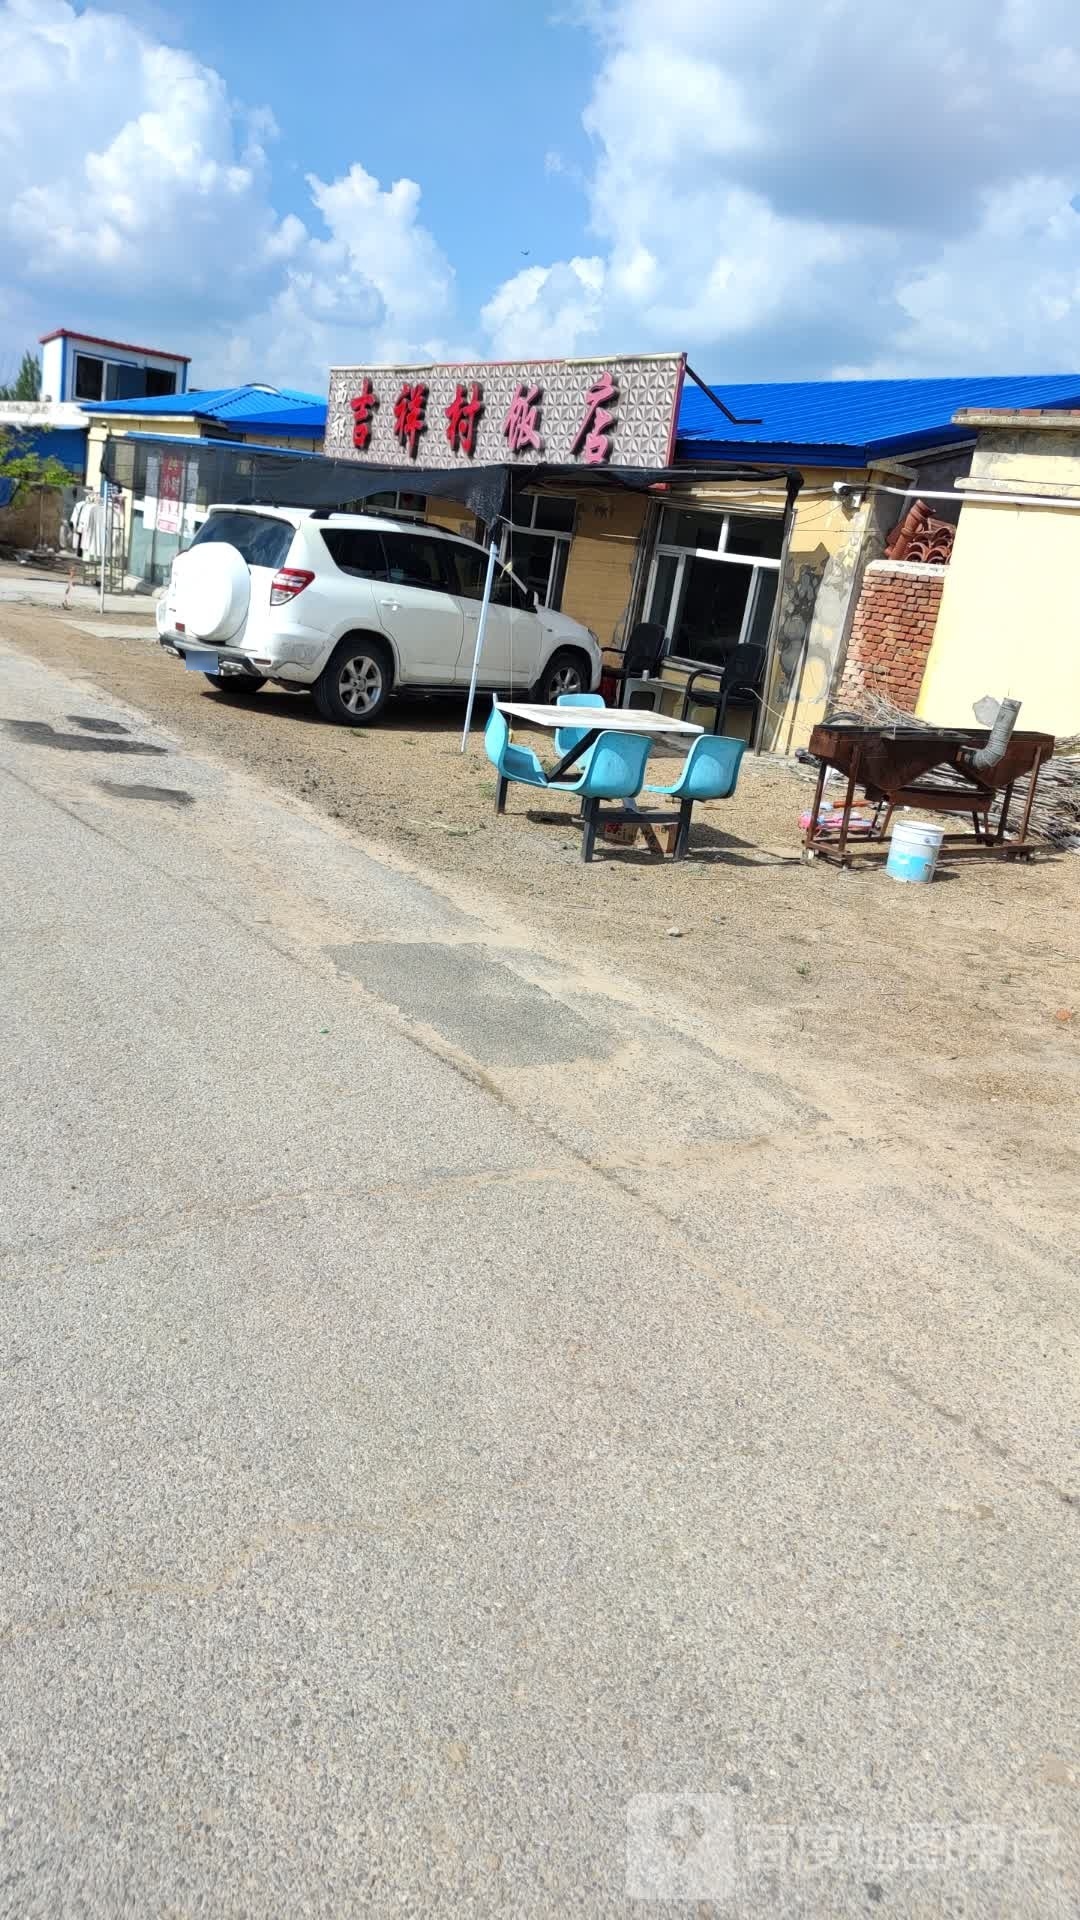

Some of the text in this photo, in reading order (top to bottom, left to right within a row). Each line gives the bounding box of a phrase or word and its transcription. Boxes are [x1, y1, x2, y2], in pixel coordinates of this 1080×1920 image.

[350, 371, 617, 464] 吉祥村饭店
